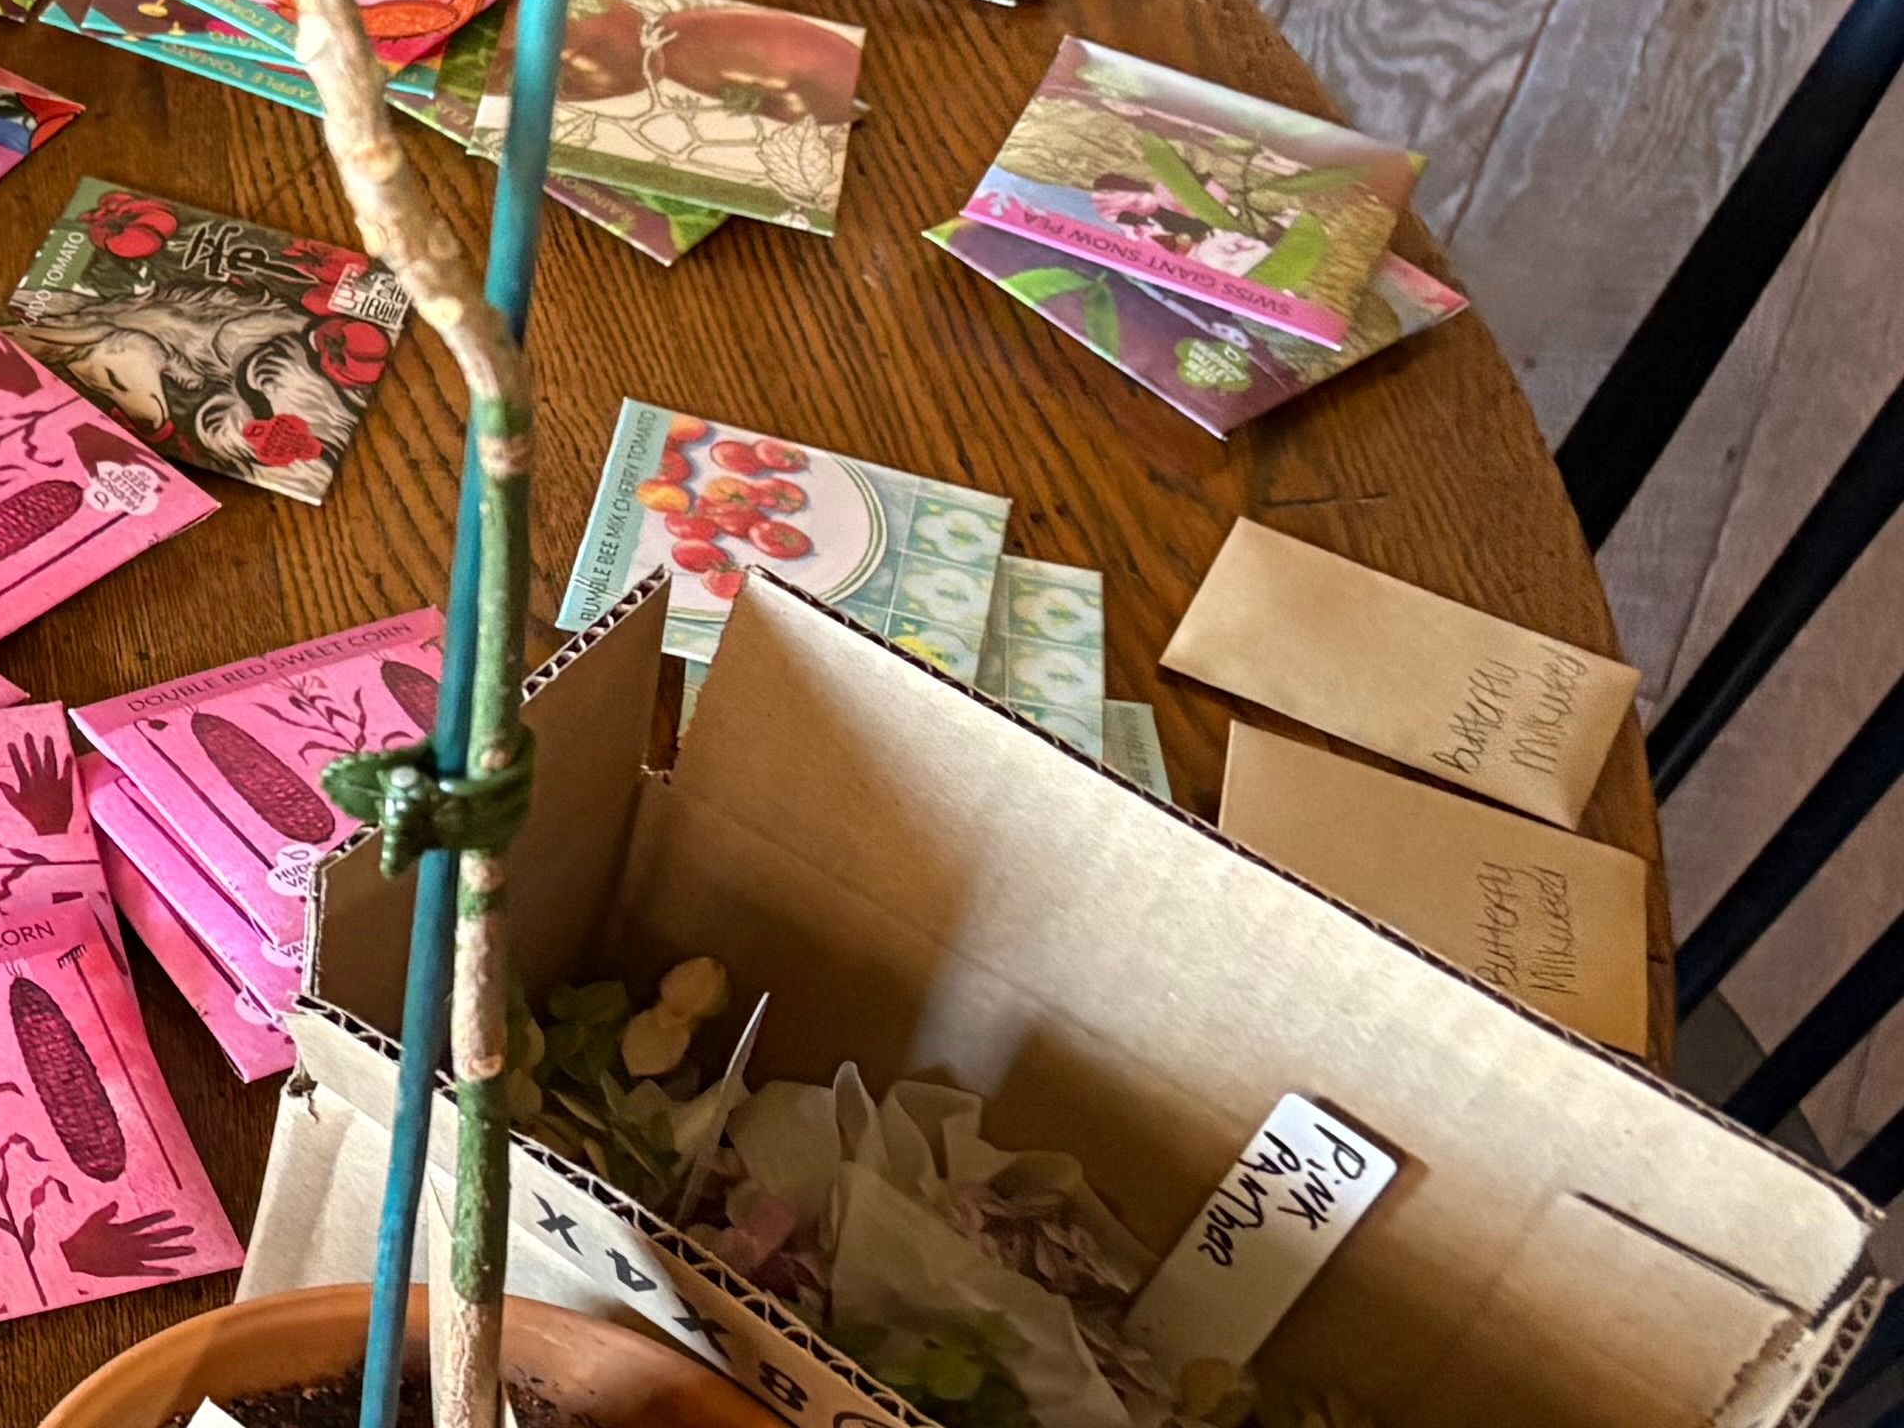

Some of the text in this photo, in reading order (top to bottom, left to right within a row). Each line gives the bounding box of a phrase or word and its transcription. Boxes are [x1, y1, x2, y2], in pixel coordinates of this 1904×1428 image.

[42, 231, 85, 301] TOMATO
[1072, 229, 1141, 263] SNOW
[1147, 256, 1219, 288] GIANT
[1223, 282, 1291, 315] SWISS
[597, 540, 619, 566] BEE
[127, 623, 412, 713] DOUBLE RED SWEET CORN
[531, 1189, 586, 1258] X
[609, 1244, 660, 1295] 4
[758, 1358, 811, 1415] 8
